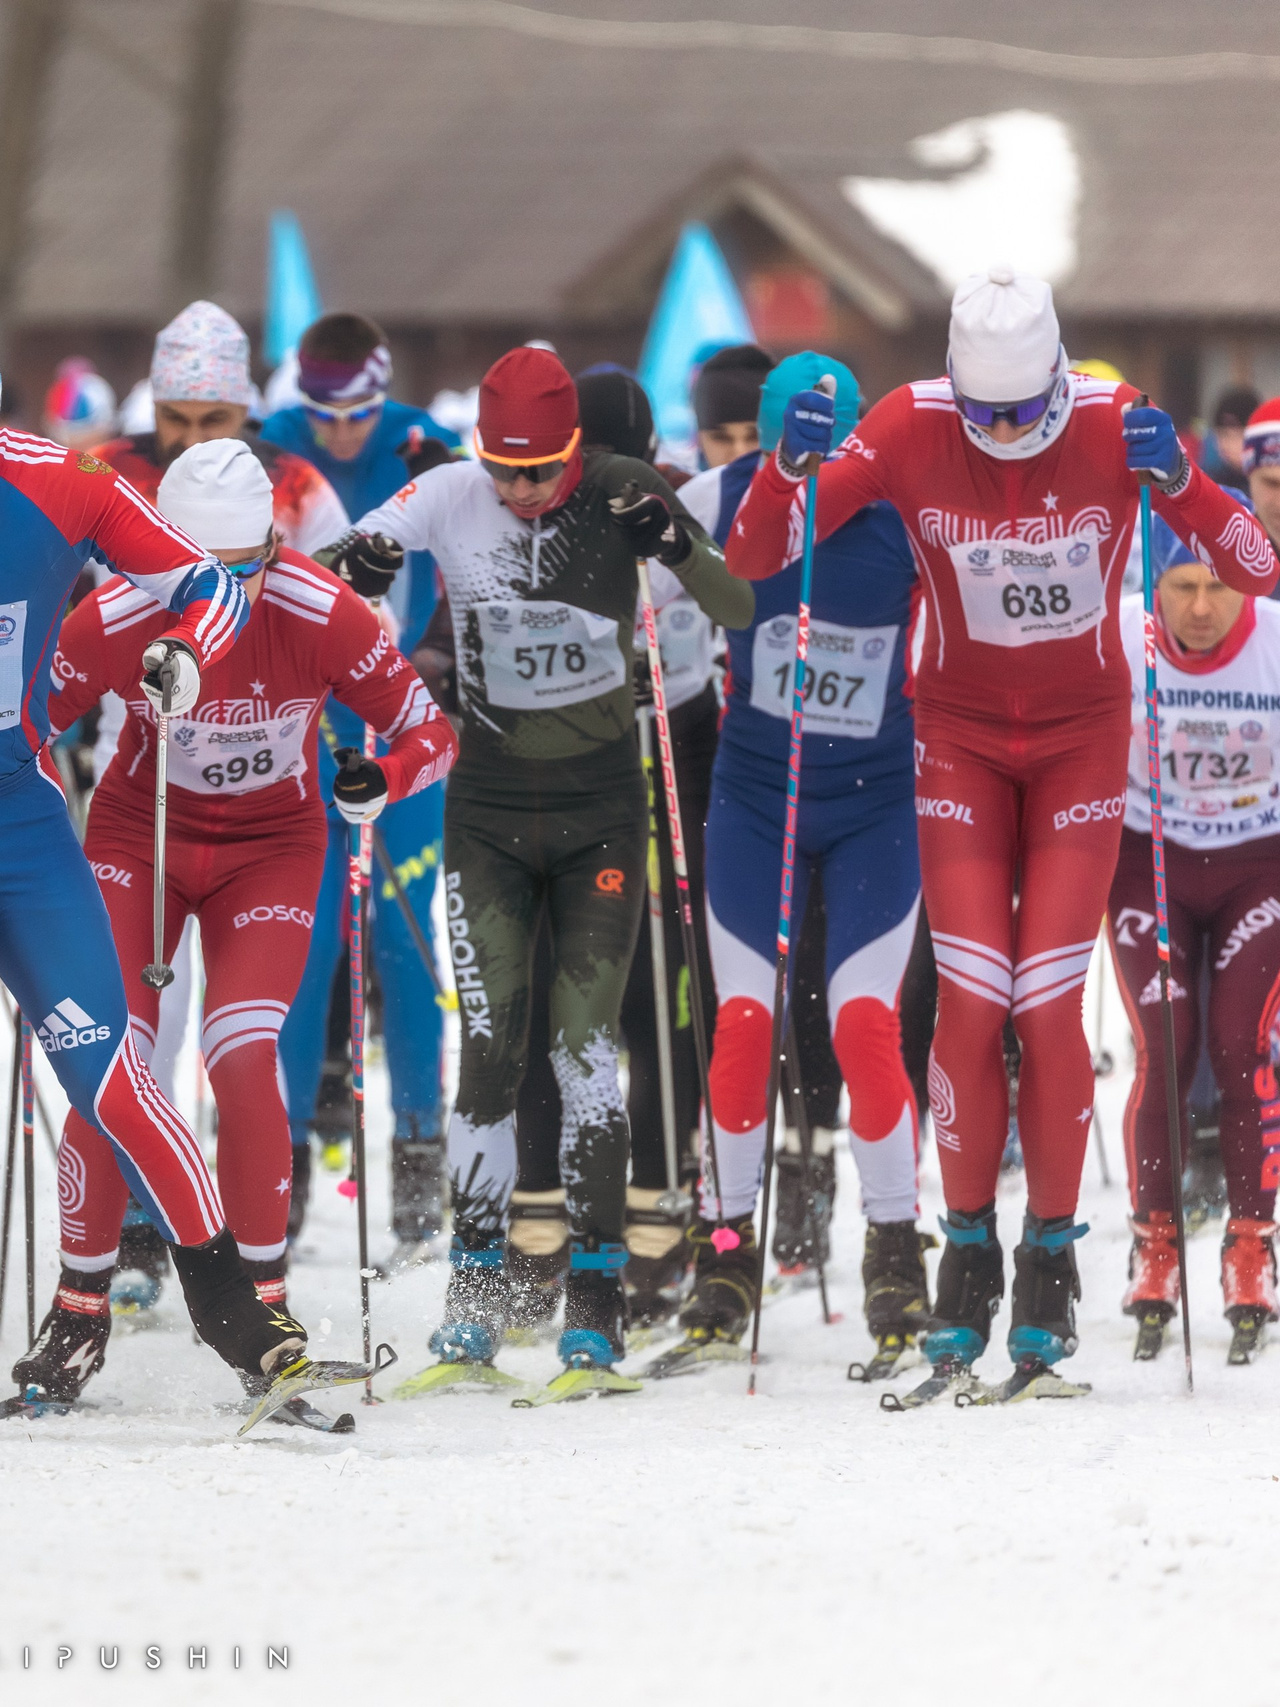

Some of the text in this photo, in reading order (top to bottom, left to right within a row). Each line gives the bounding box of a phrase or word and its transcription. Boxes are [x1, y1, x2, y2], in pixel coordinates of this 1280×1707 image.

[1002, 557, 1057, 568] РОССИИ
[1002, 582, 1073, 619] 638
[515, 642, 586, 680] 578
[1155, 688, 1280, 712] АЗПРОМБАНК
[208, 735, 268, 744] РОССИИ
[209, 728, 266, 738] ЛЫЖНЯ
[201, 748, 274, 787] 698
[1162, 750, 1251, 781] 1732
[233, 905, 315, 929] BOSCO
